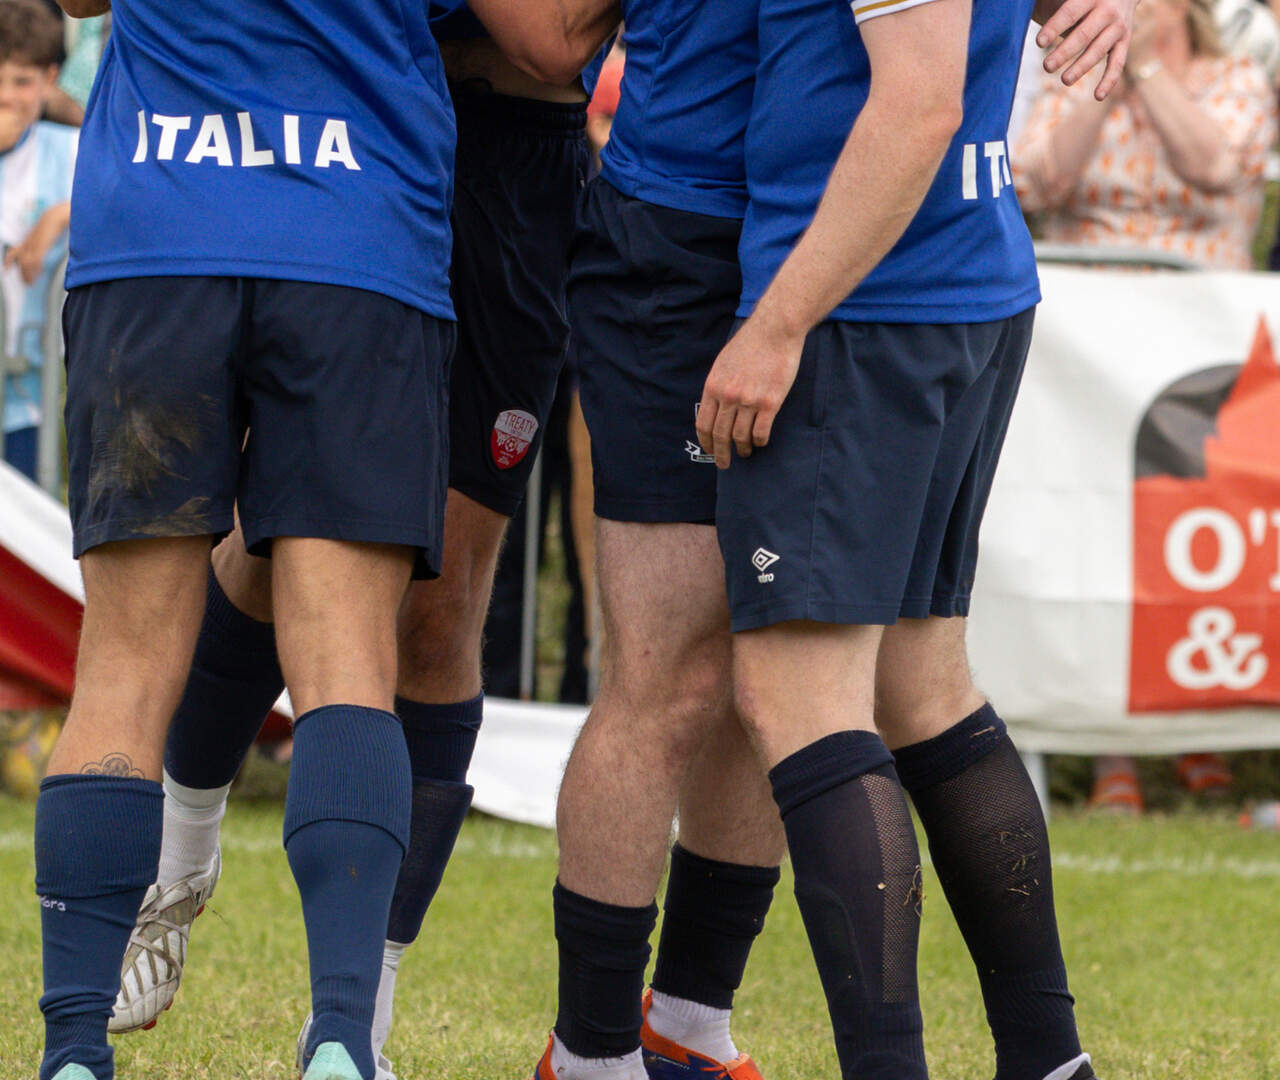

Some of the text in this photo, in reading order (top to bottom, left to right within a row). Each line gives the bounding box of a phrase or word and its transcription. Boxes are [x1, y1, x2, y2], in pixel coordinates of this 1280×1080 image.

[131, 109, 362, 171] ITALIA
[504, 412, 537, 435] TREATY
[1165, 606, 1269, 690] &
